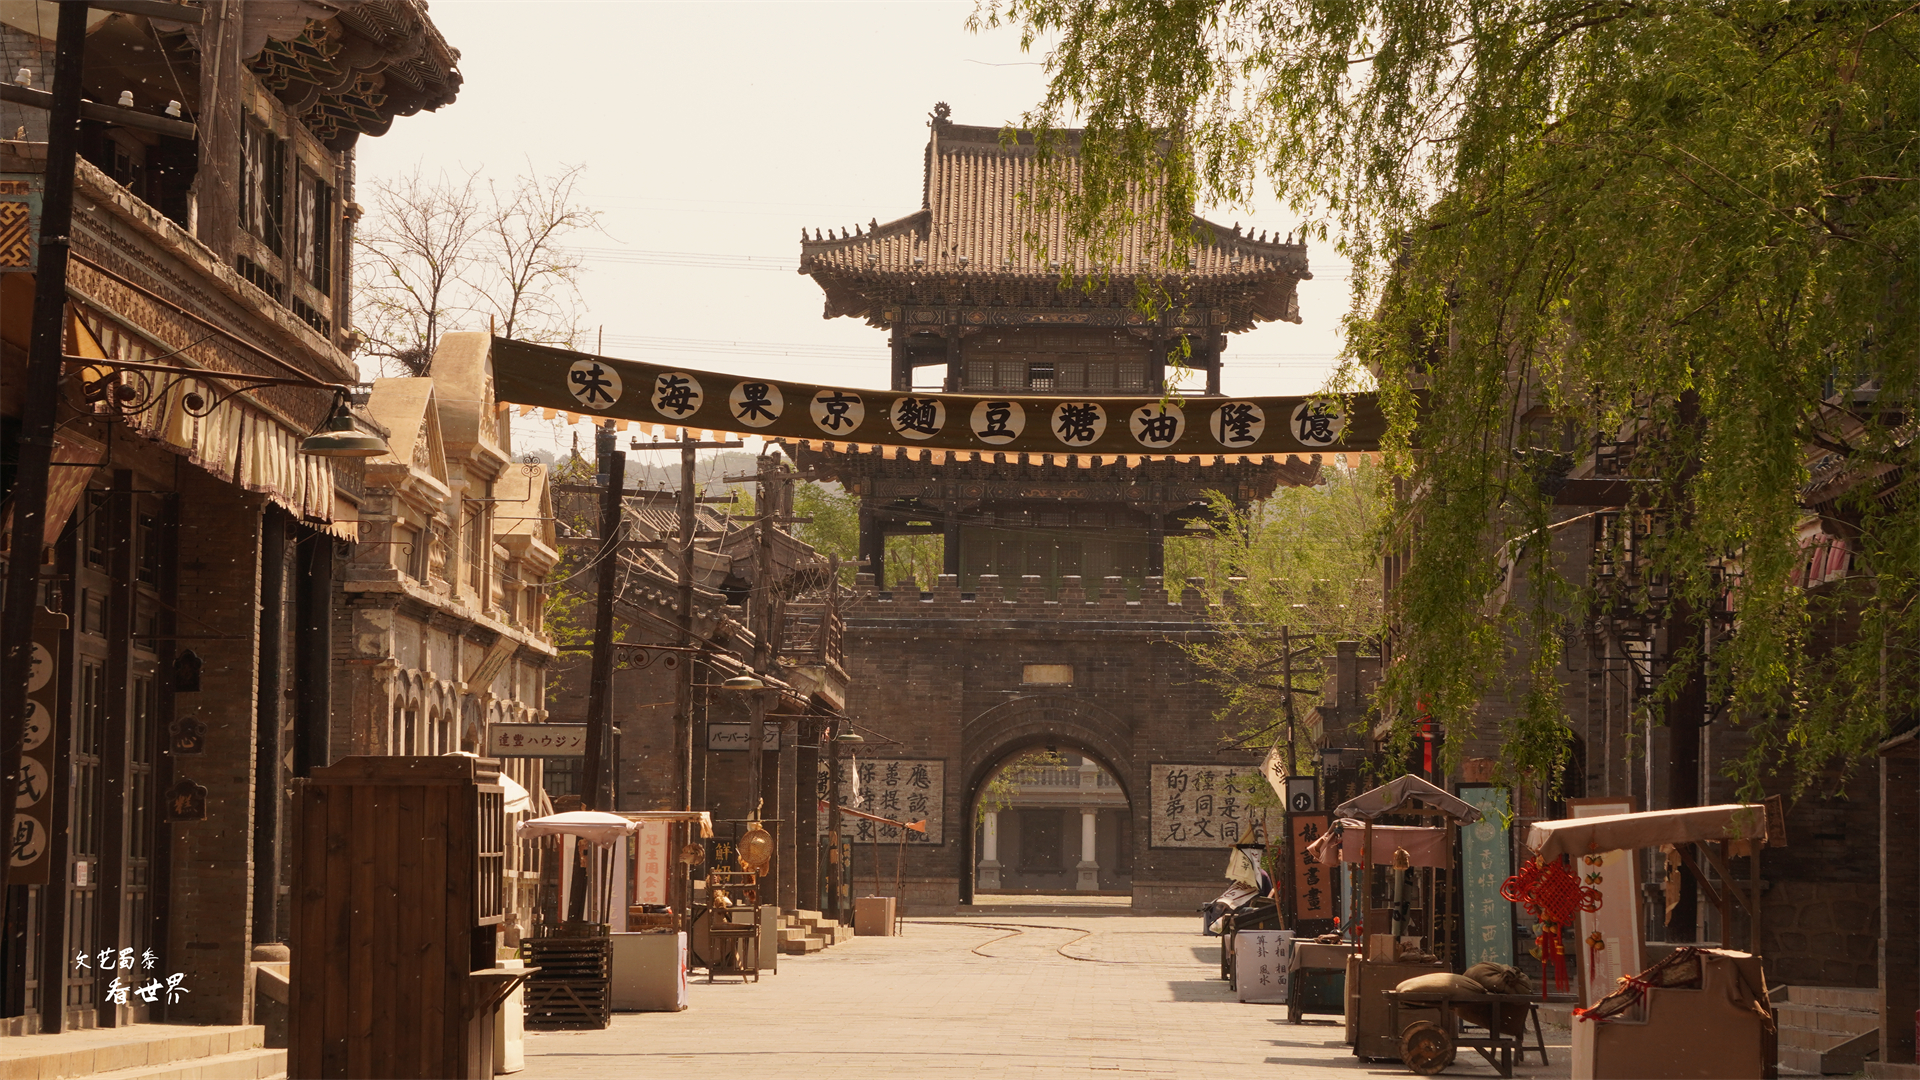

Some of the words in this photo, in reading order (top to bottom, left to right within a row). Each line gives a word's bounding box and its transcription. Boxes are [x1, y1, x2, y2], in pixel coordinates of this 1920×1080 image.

[498, 732, 587, 748] 達豐ハウジン
[1163, 768, 1189, 842] 的弟兄
[1191, 770, 1216, 838] 種同文
[642, 833, 661, 903] 冠生園食品
[714, 841, 733, 898] 鮮奶
[1256, 935, 1269, 958] 算卦
[1274, 934, 1286, 958] 手相
[1275, 962, 1287, 985] 相面
